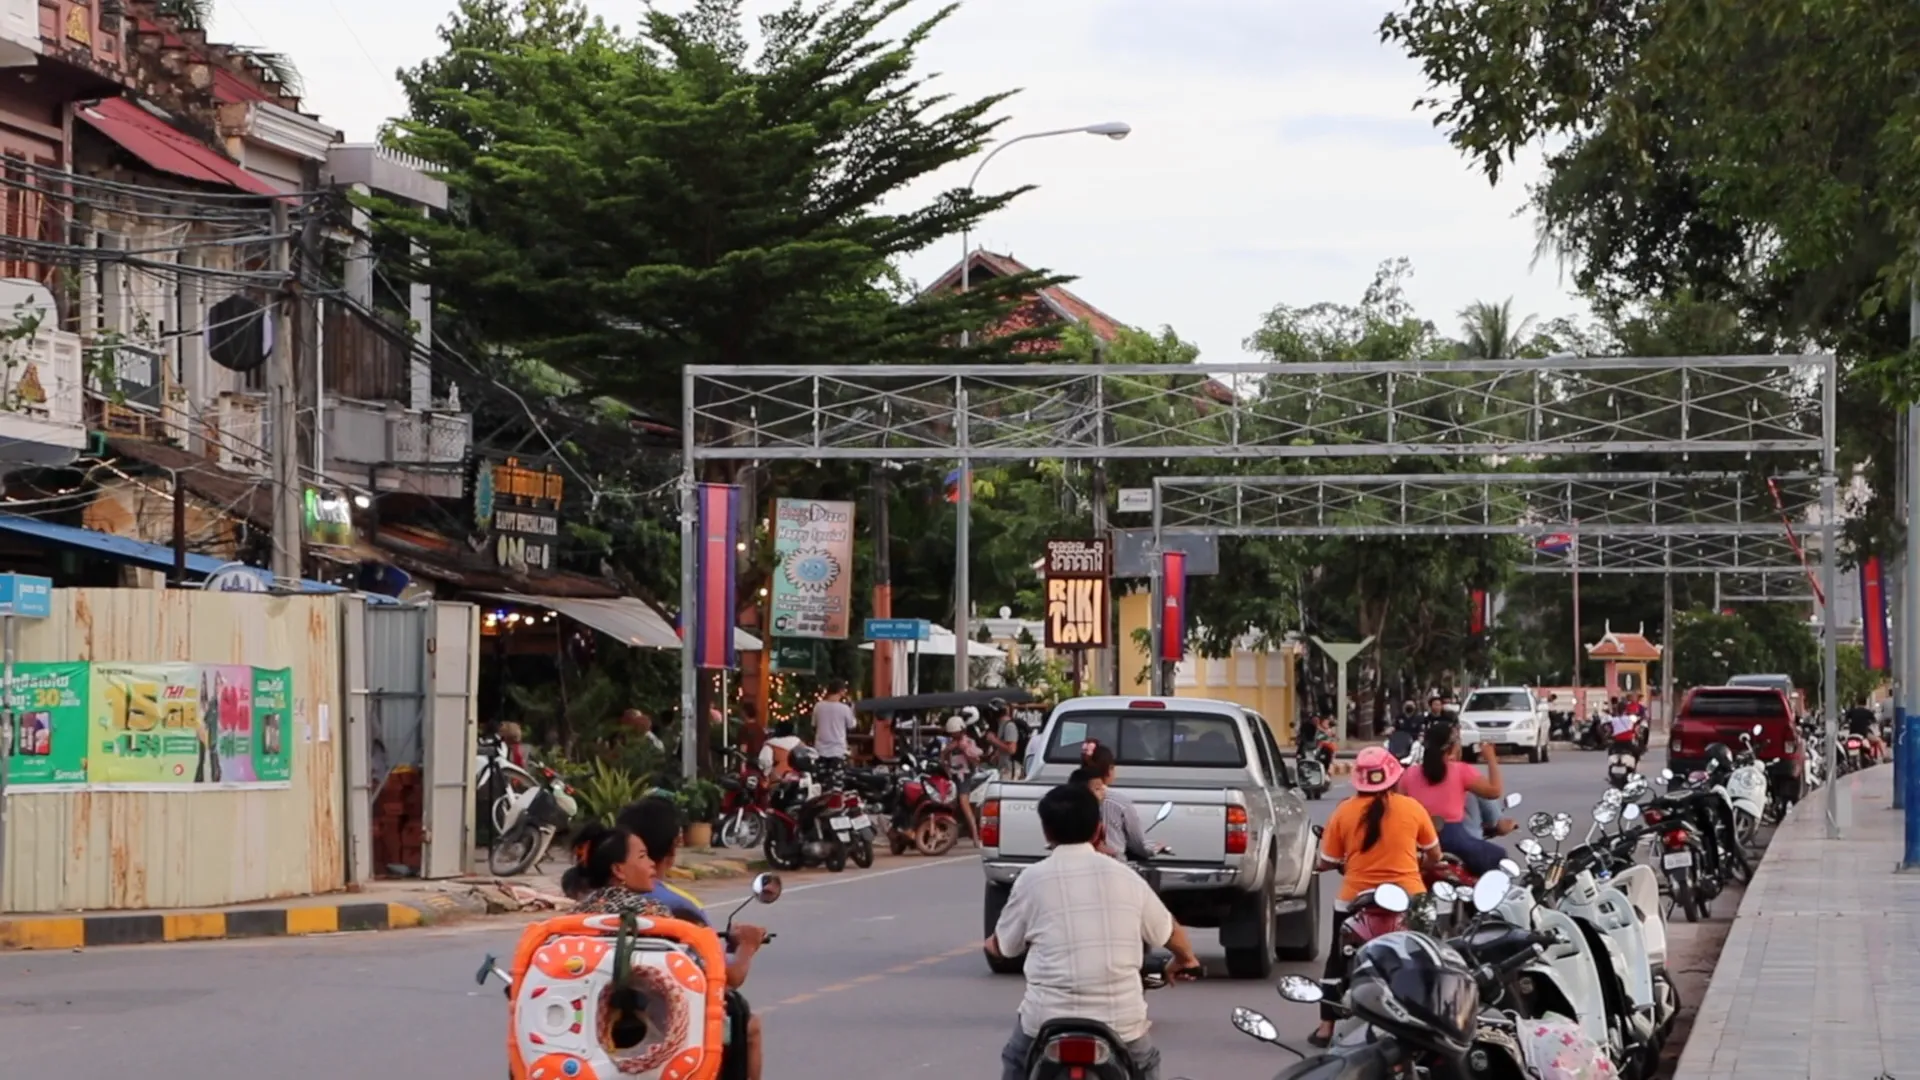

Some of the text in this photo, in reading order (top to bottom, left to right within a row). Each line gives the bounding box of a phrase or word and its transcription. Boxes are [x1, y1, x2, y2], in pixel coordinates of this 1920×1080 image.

[777, 526, 810, 543] Happy
[34, 688, 60, 707] 30
[103, 682, 160, 731] 15
[54, 769, 85, 780] Smart
